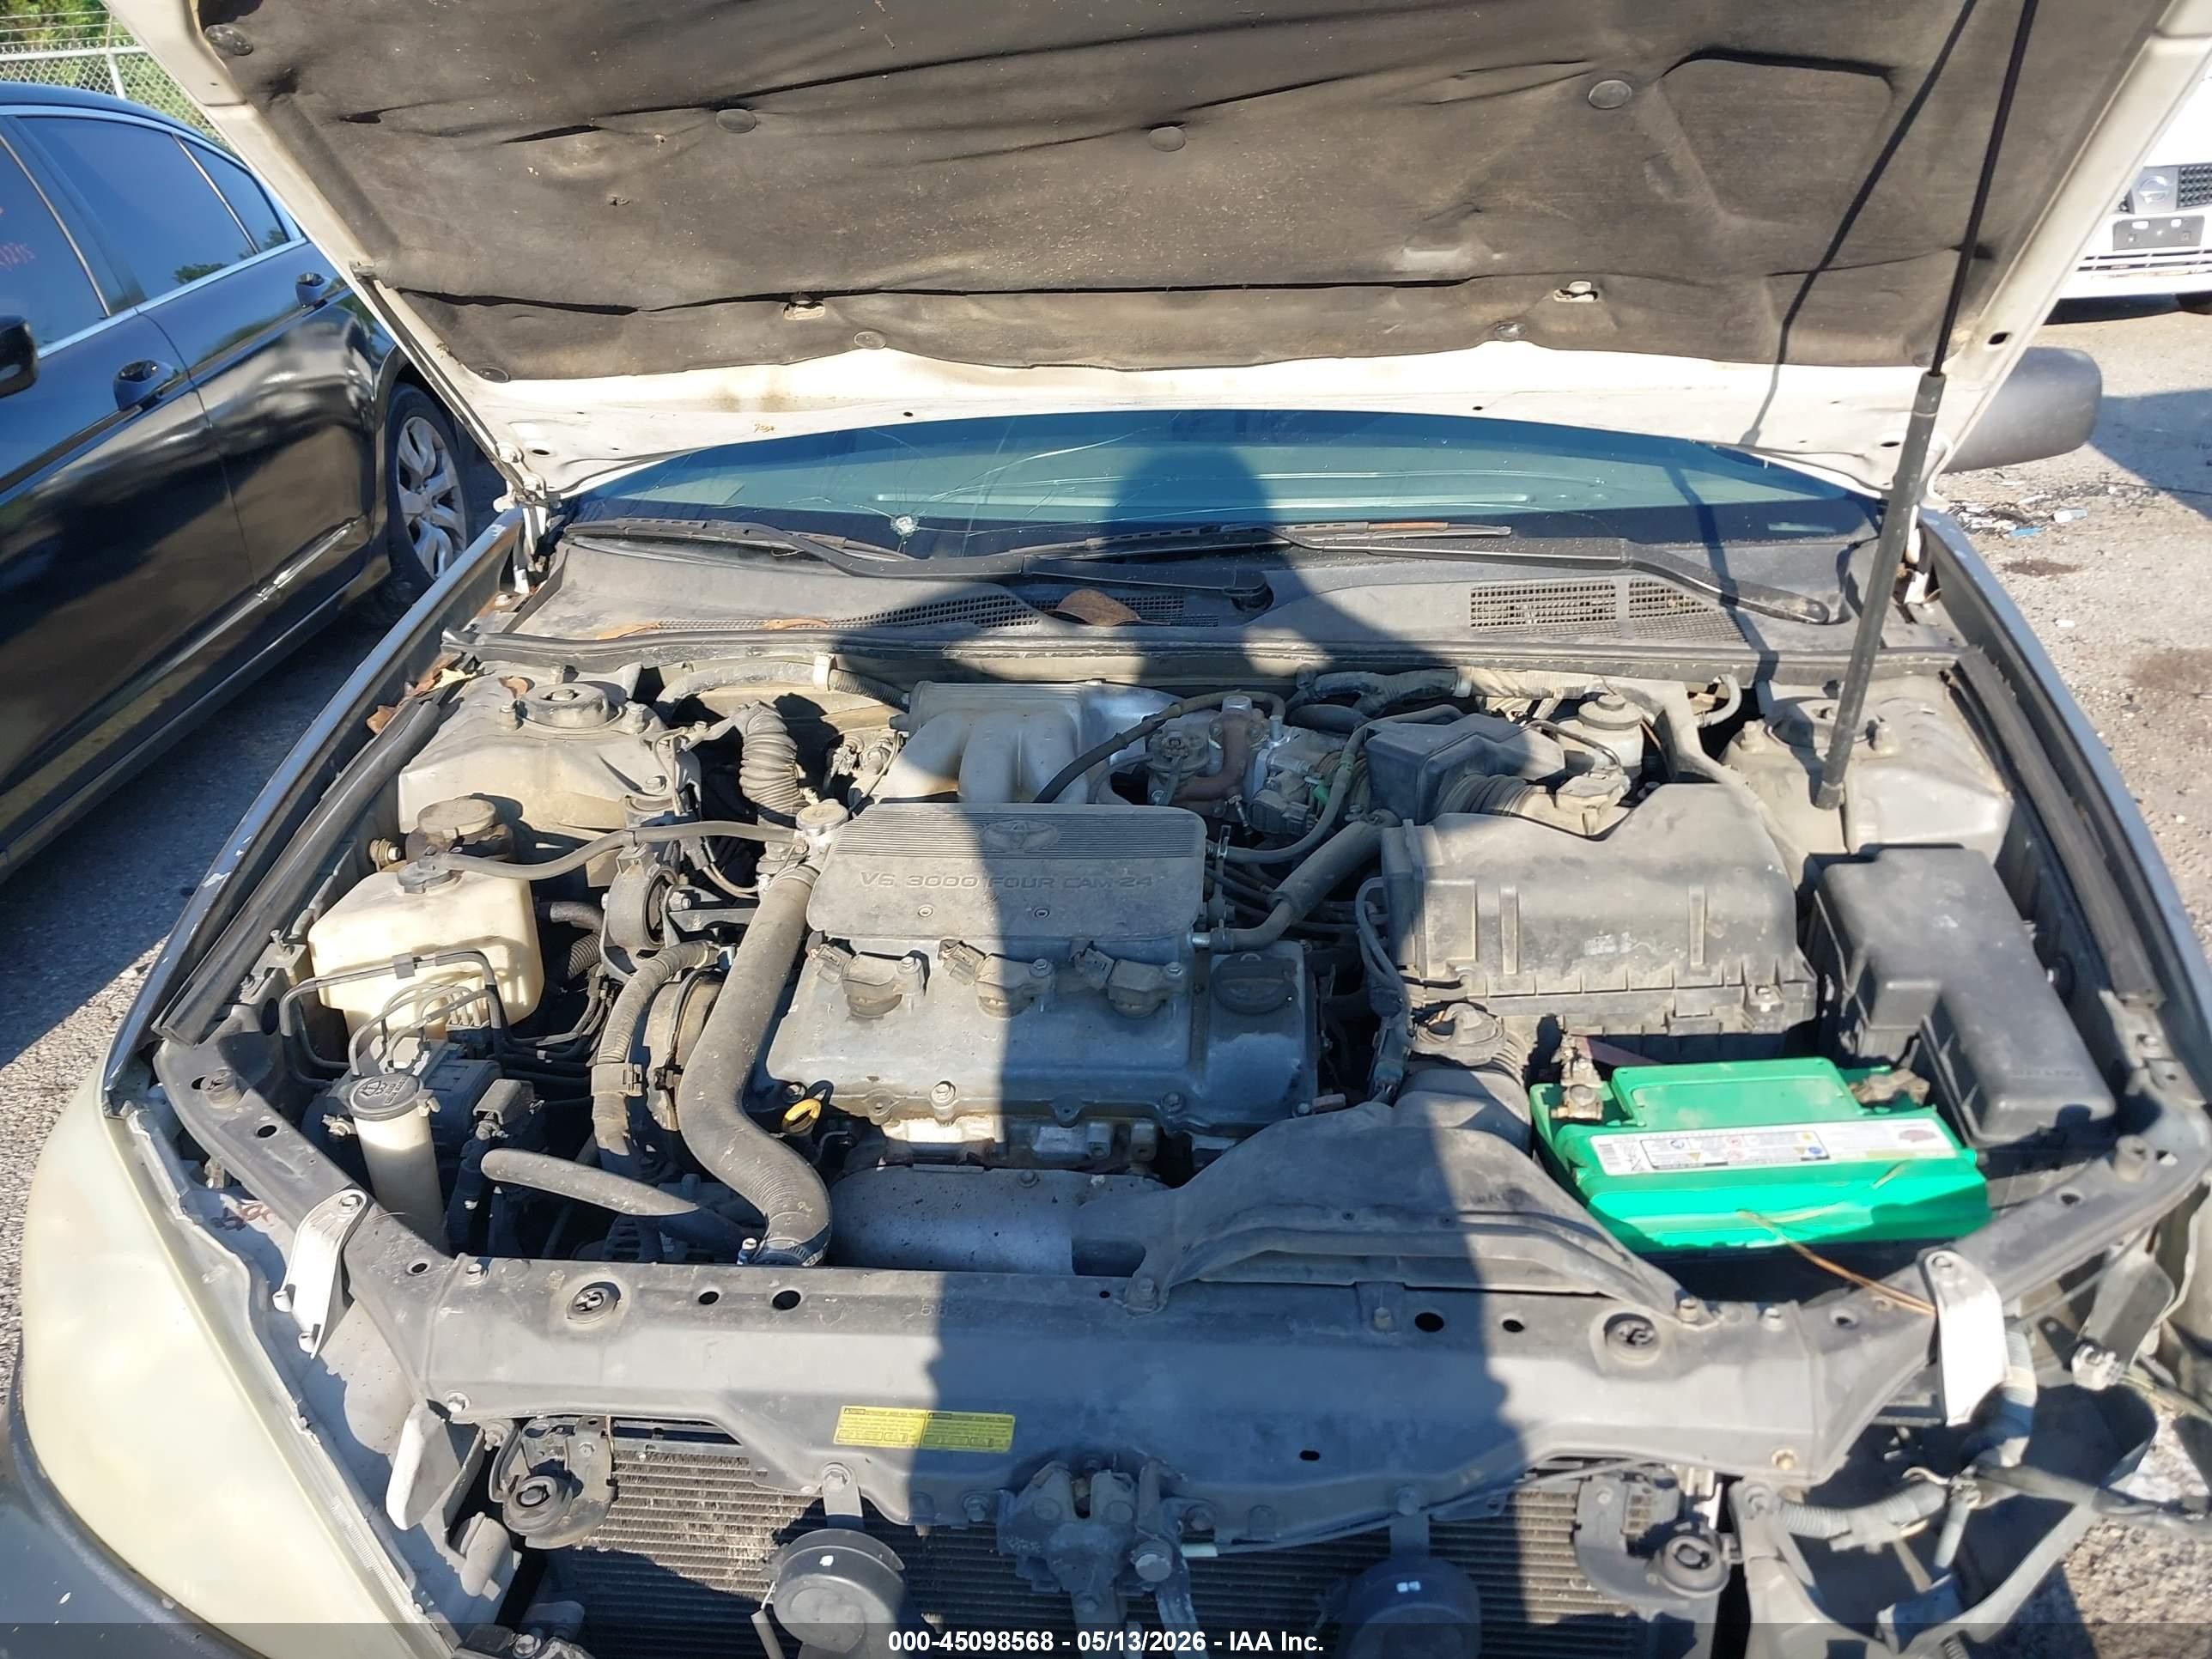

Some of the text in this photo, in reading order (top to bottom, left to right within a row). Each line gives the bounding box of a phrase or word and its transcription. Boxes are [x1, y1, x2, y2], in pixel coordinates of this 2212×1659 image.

[860, 871, 896, 887] V6
[905, 874, 980, 889] 3000
[988, 875, 1055, 890] FOUR
